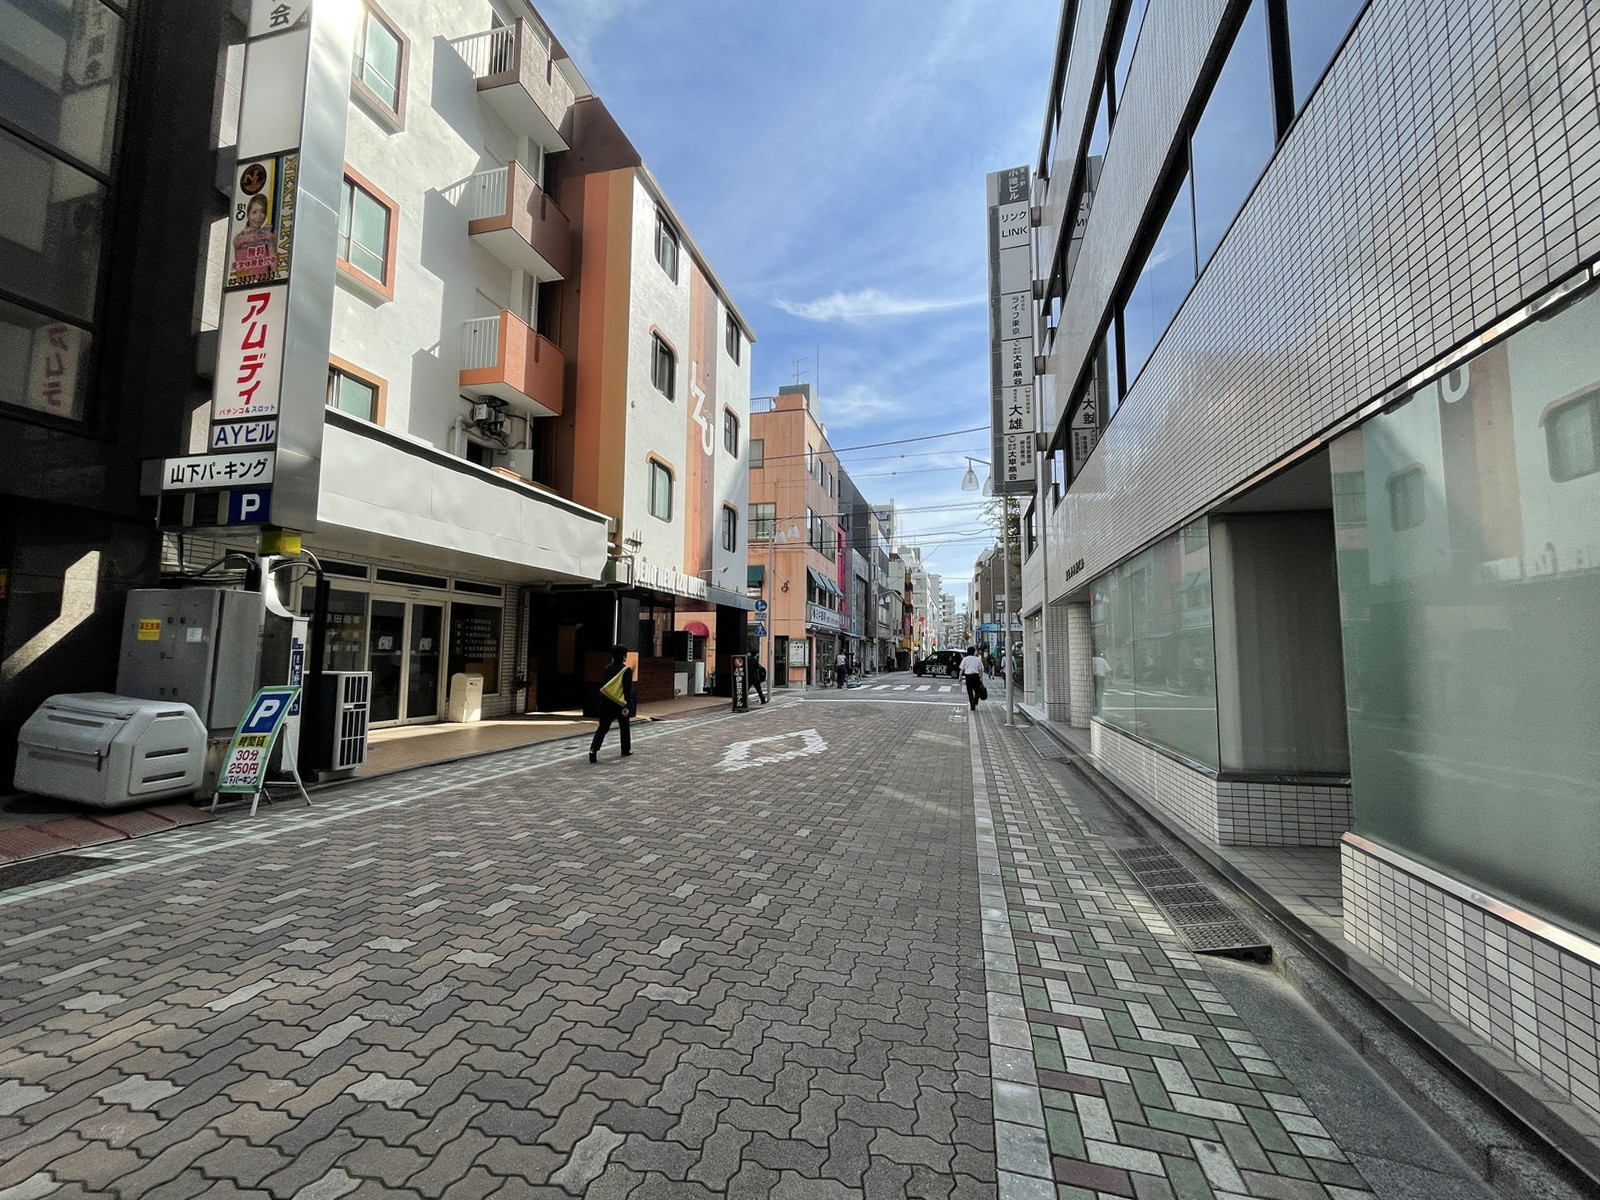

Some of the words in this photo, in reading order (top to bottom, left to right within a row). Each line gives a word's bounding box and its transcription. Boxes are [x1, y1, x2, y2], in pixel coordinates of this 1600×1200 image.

[284, 156, 298, 210] NEXT
[1002, 211, 1026, 223] リンク
[1002, 226, 1027, 238] LINK
[277, 213, 293, 272] LEVEL
[214, 423, 275, 446] AYビル
[240, 493, 261, 521] P
[249, 700, 280, 728] P
[238, 735, 267, 748] 時間貸
[236, 750, 260, 761] 30分
[228, 762, 260, 775] 250円
